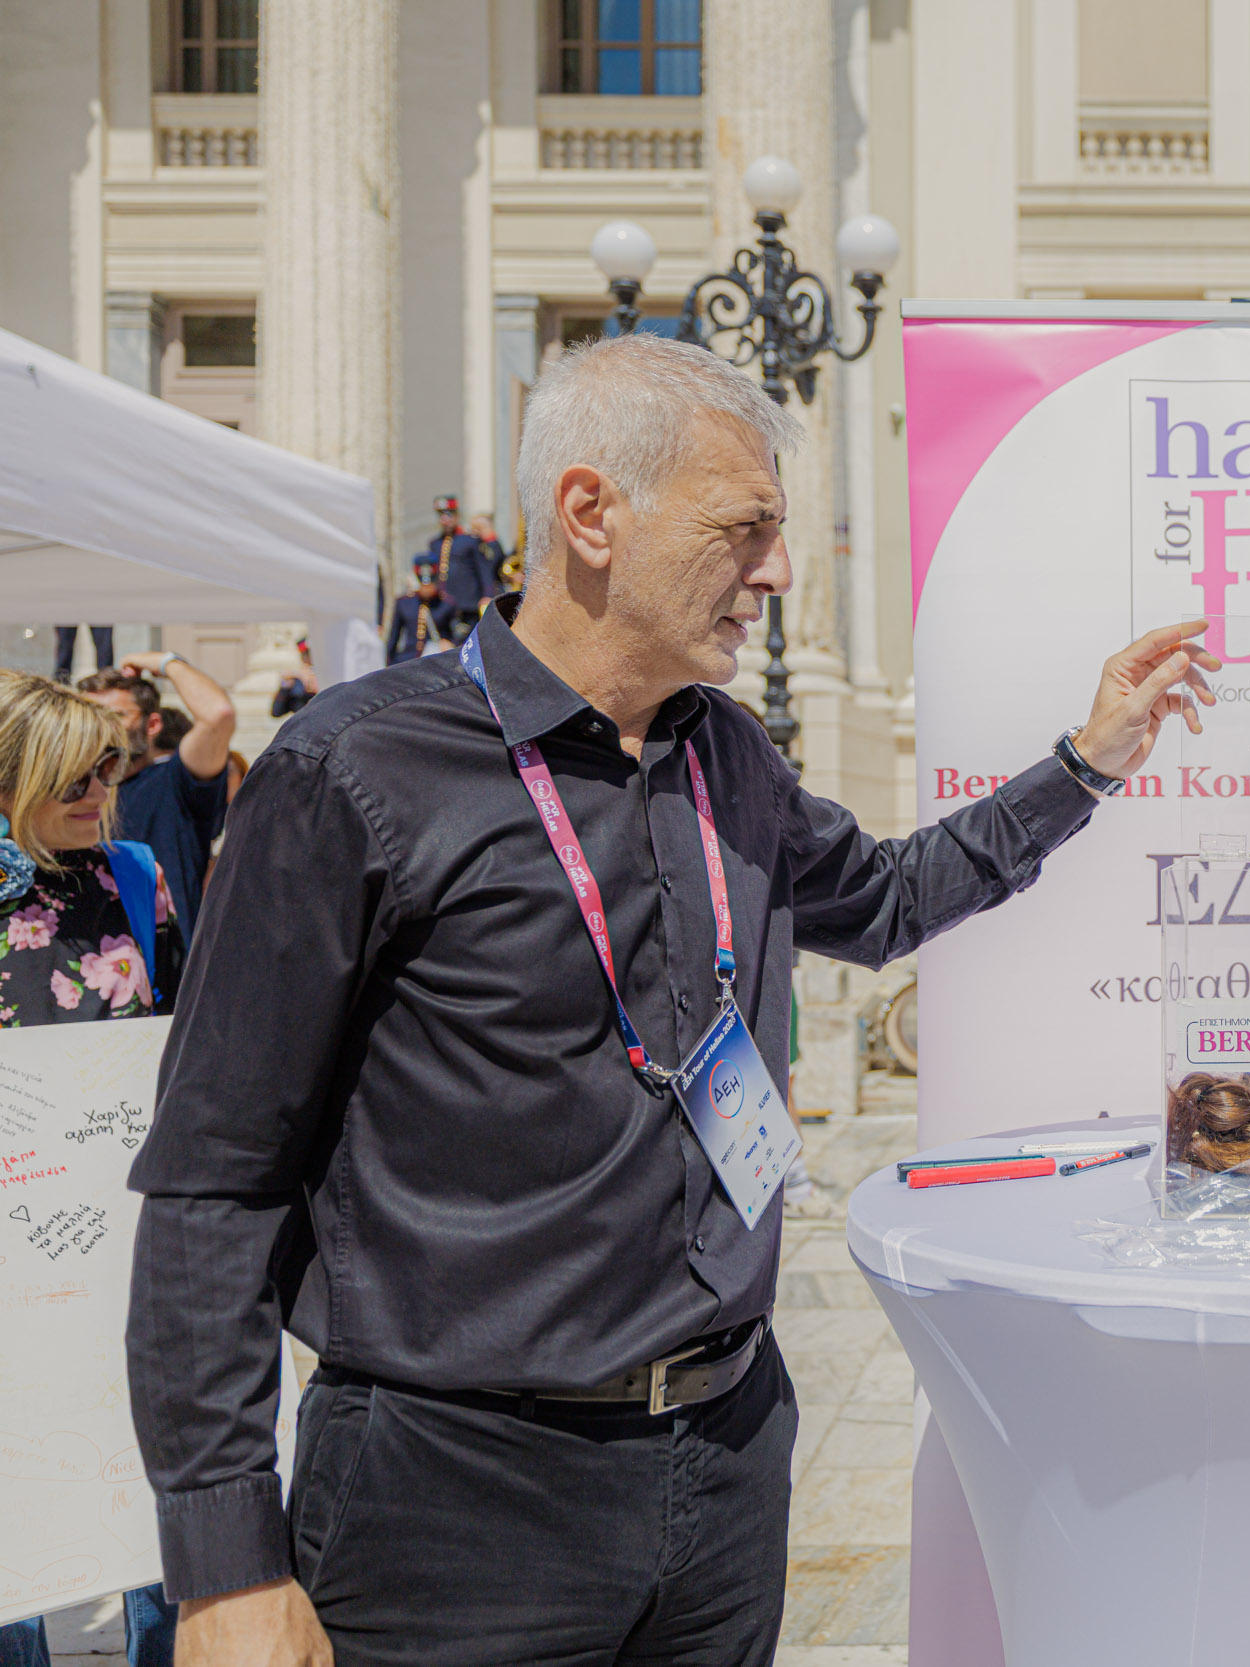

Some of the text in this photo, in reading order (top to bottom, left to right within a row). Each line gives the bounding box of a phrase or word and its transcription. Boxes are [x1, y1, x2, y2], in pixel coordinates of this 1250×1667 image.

[1154, 500, 1192, 565] for
[514, 743, 529, 767] ELLAS
[540, 800, 558, 832] HELLAS
[568, 867, 587, 898] HELLAS
[692, 1059, 704, 1076] Tour
[703, 1050, 711, 1062] of
[708, 1033, 724, 1055] Hellas
[0, 1150, 36, 1173] γάπη
[36, 1204, 91, 1250] τα μαλλιά
[47, 1242, 69, 1261] μας
